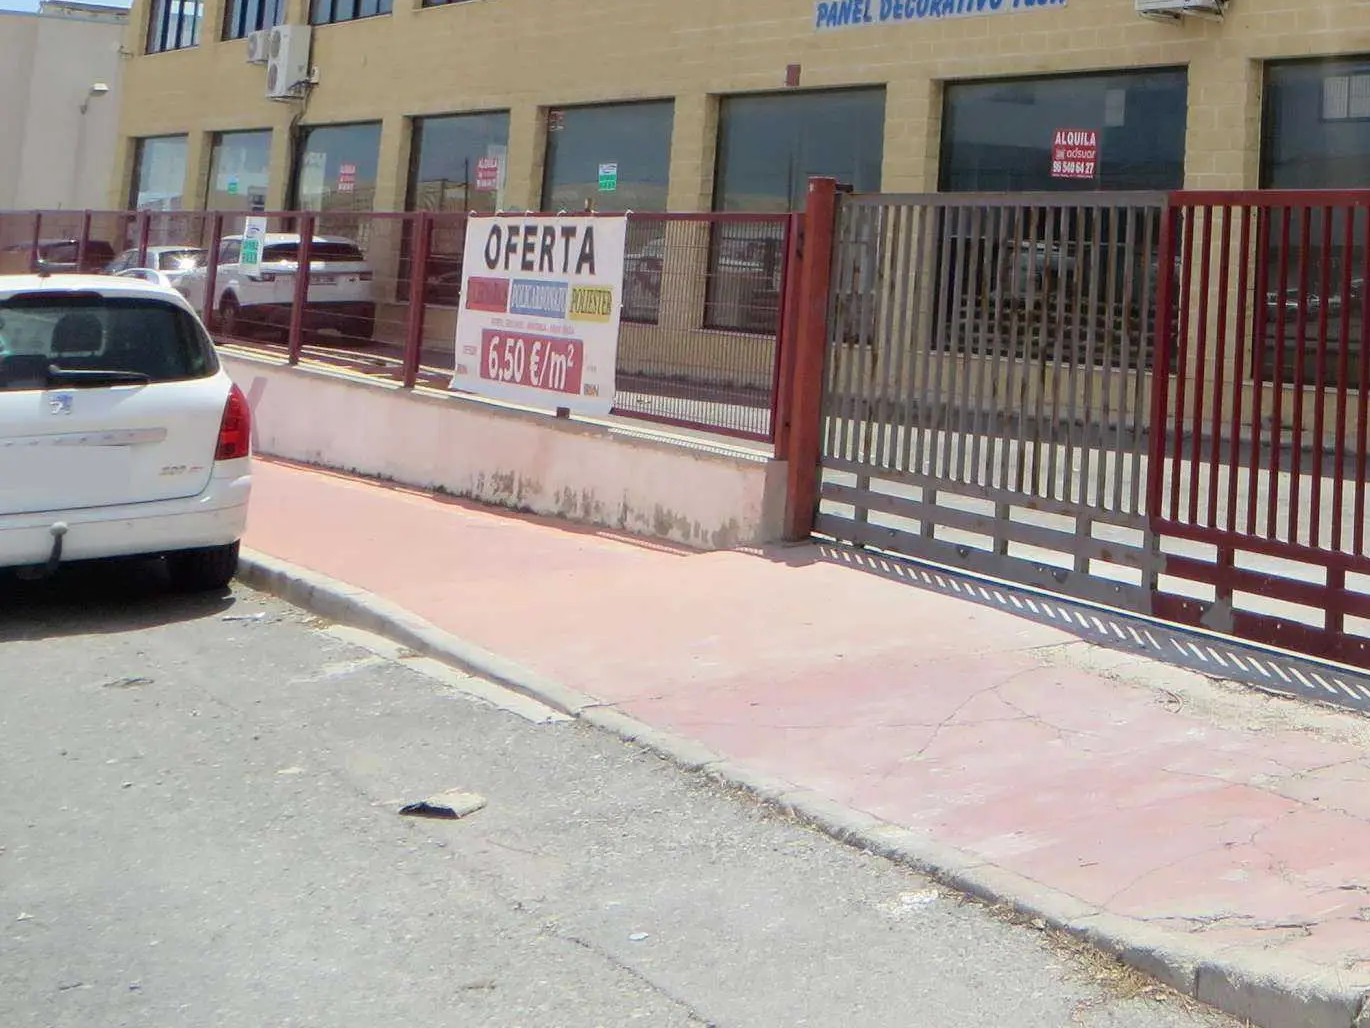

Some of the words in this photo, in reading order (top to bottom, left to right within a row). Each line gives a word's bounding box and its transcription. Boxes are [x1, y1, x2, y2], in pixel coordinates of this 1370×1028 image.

[1055, 131, 1096, 146] ALQUILA
[484, 223, 597, 275] OFERTA
[488, 335, 525, 383] 6,50
